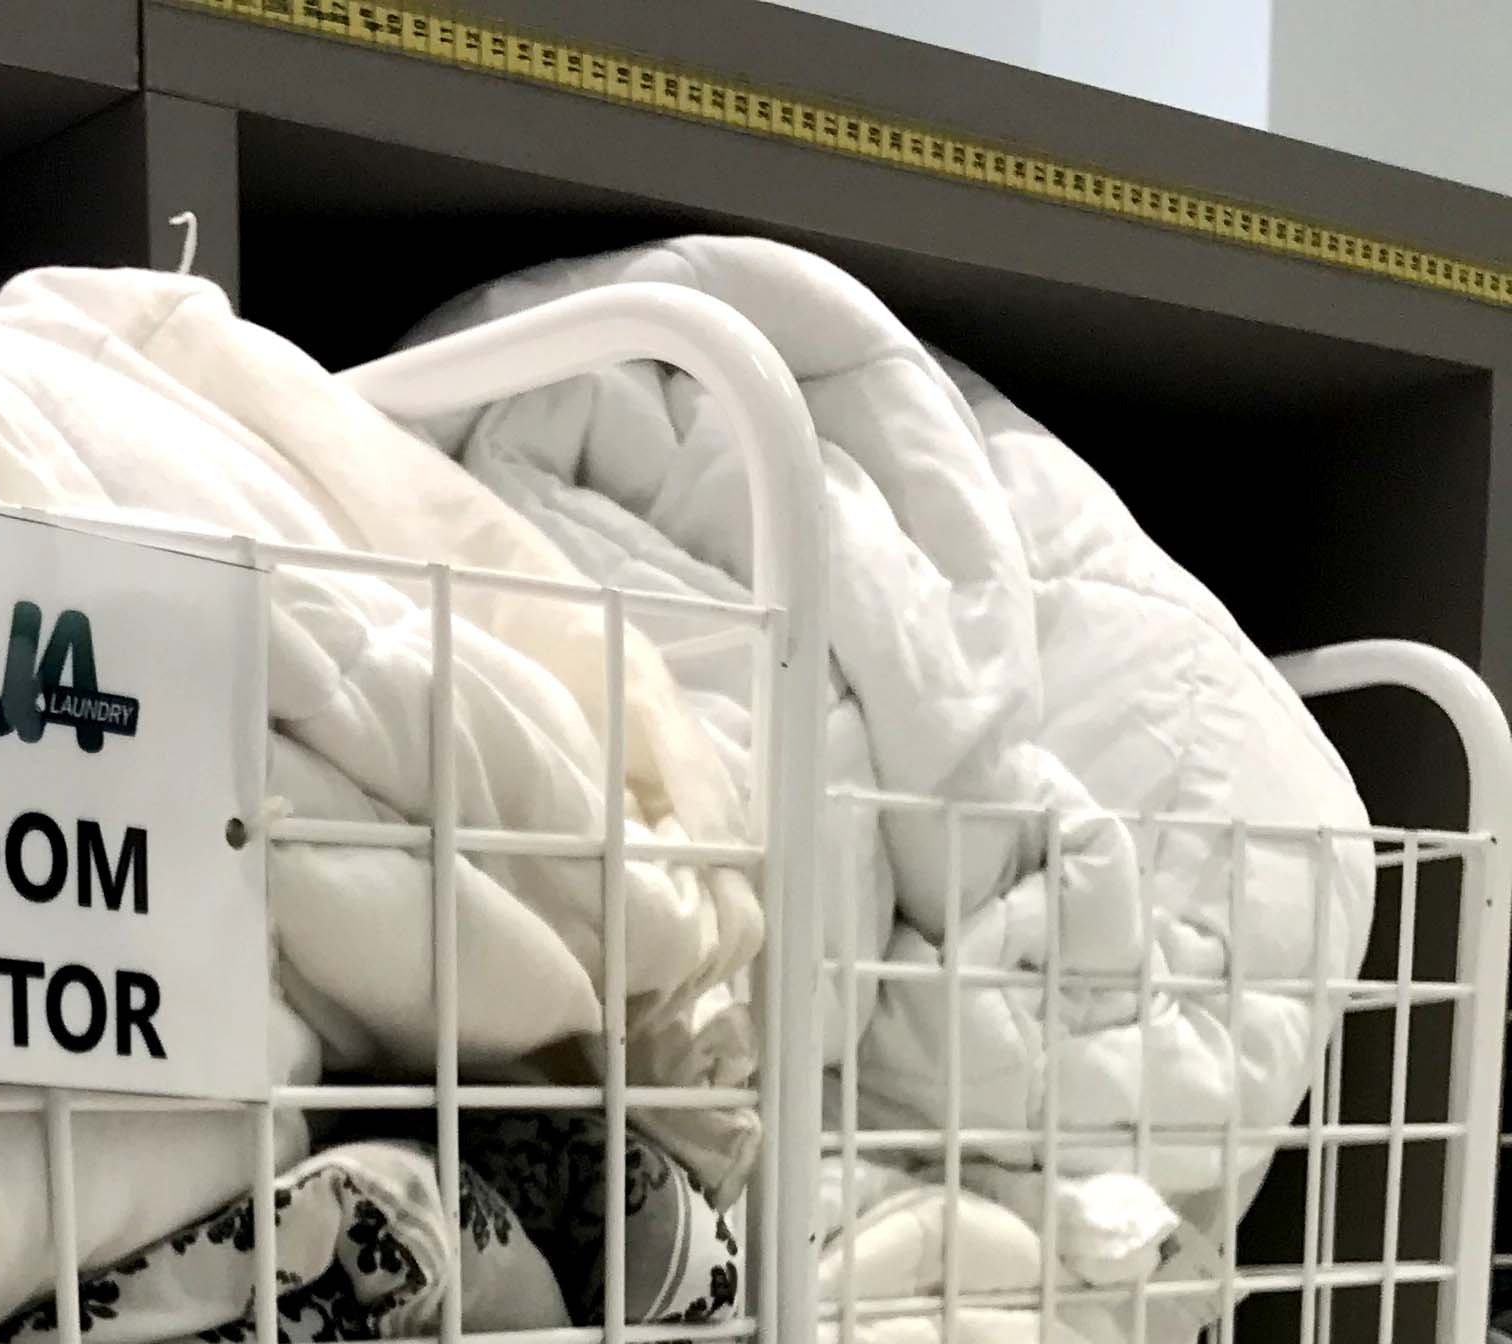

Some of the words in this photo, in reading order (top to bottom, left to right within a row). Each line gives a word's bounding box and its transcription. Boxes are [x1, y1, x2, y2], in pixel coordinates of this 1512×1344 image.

[412, 19, 429, 38] 10
[439, 26, 454, 44] 11
[465, 30, 482, 50] 12
[491, 37, 507, 57] 13
[517, 43, 532, 62] 14
[542, 47, 557, 67] 15
[591, 60, 607, 80] 17
[616, 67, 631, 85] 18
[640, 70, 656, 90] 19
[664, 80, 680, 100] 20
[688, 85, 702, 105] 21
[711, 91, 727, 111] 22
[734, 95, 749, 116] 23
[757, 101, 771, 121] 24
[49, 693, 134, 727] LAUNDRY
